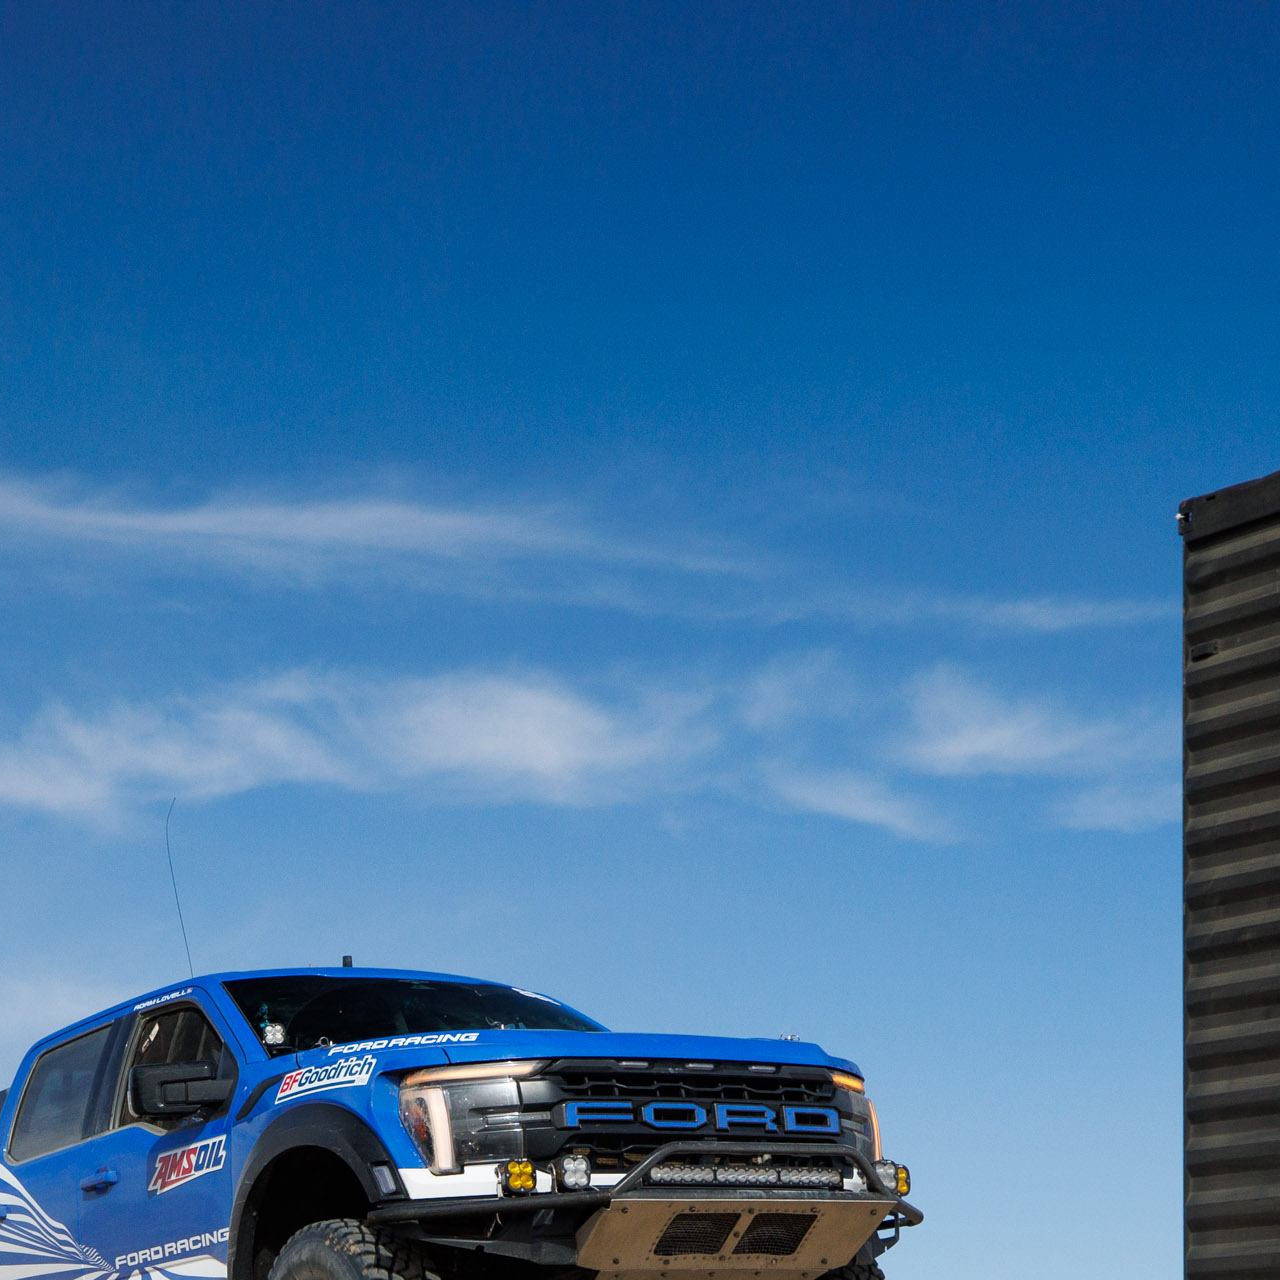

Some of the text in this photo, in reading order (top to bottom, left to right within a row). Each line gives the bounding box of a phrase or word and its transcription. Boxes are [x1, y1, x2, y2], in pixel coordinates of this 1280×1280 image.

[279, 1056, 375, 1094] BFGoodrich
[565, 1101, 841, 1134] FORD
[152, 1139, 225, 1188] AMSOIL
